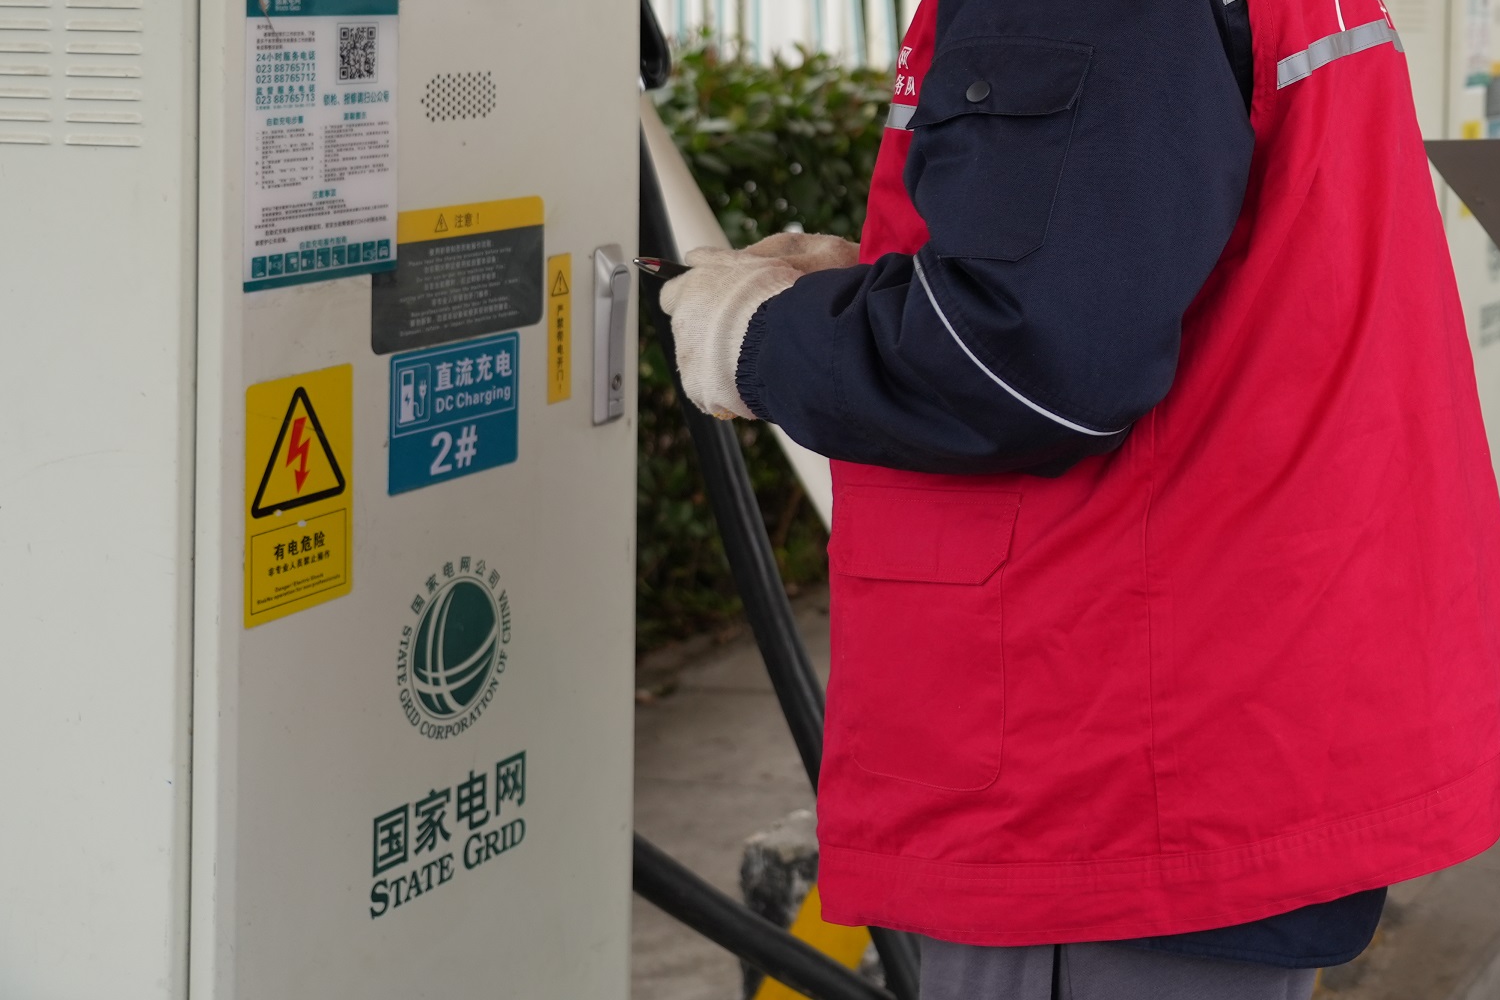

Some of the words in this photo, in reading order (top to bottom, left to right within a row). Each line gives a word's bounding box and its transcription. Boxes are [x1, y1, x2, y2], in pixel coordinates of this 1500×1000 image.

[256, 51, 316, 62] 24小时服务电话
[256, 64, 272, 74] 023
[274, 63, 316, 73] 88765711
[256, 75, 272, 84] 023
[274, 73, 316, 83] 88765712
[256, 95, 272, 104] 023
[454, 212, 481, 229] 注意！
[434, 350, 513, 392] 直流充电
[435, 395, 456, 414] DC
[457, 384, 511, 410] Charging
[429, 424, 478, 477] 2#
[274, 531, 326, 561] 有电危险
[411, 556, 500, 615] 国家电网公司
[497, 588, 512, 645] CHINA
[397, 624, 413, 688] STATE
[496, 650, 509, 675] OF
[400, 688, 420, 728] GRID
[419, 676, 500, 741] CORPORATION
[372, 750, 527, 879] 国家电网
[369, 853, 455, 921] STATE
[463, 817, 527, 872] GRID
